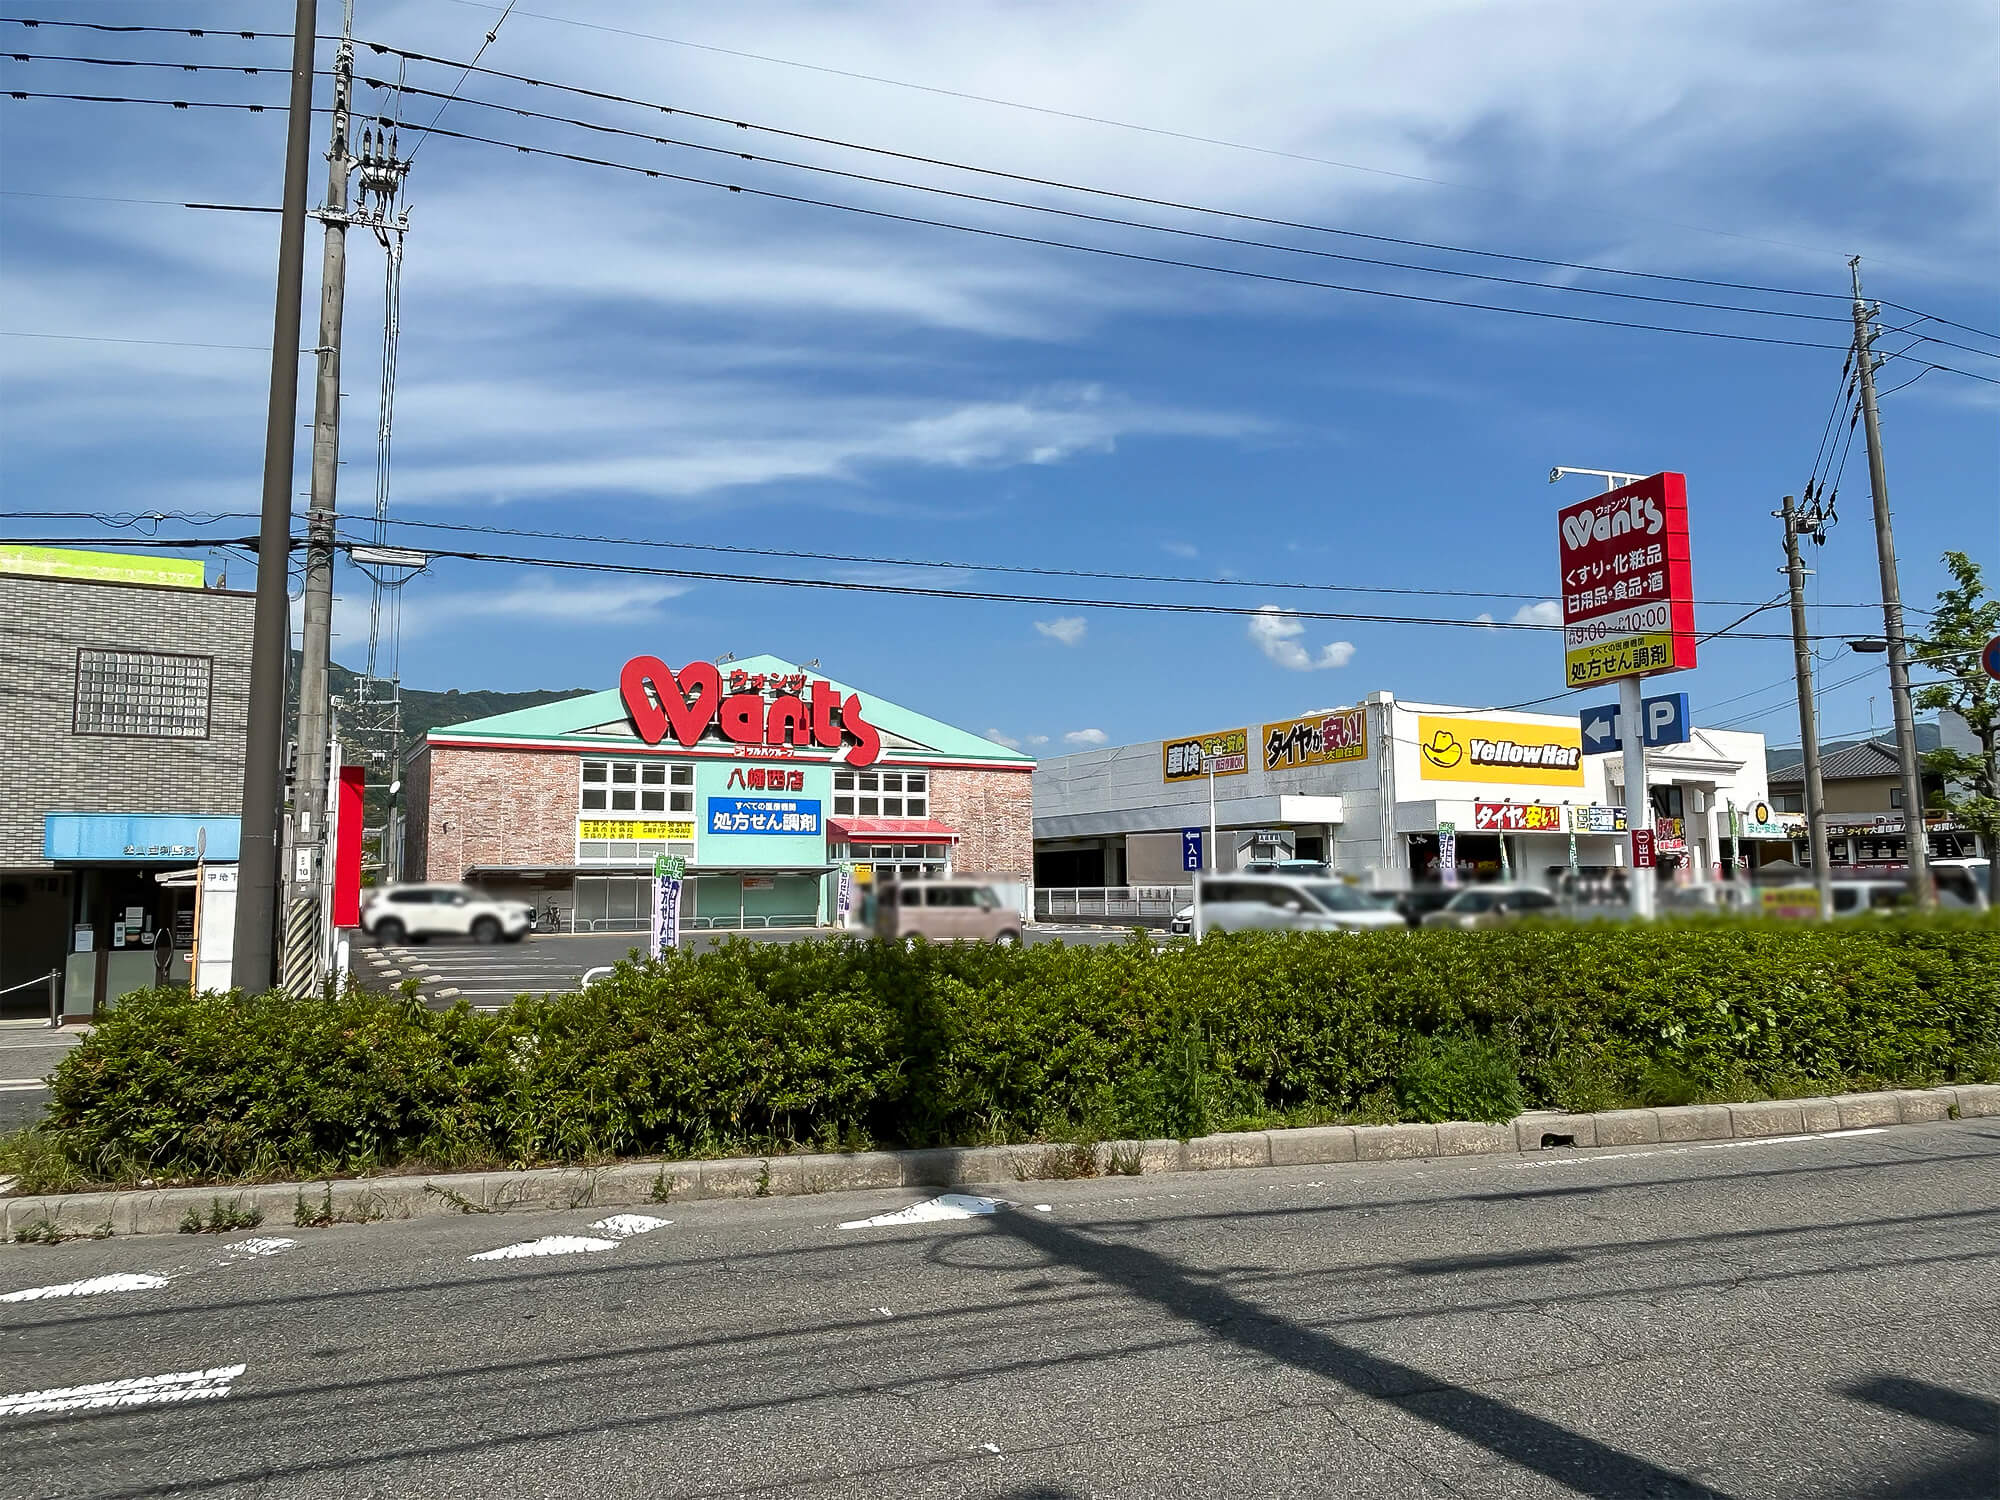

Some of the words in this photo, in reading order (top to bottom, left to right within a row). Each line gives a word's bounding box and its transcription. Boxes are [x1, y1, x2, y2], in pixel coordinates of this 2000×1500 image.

[1595, 496, 1630, 517] ウォンツ
[1562, 496, 1663, 550] Wants
[1566, 543, 1663, 587] くすり・化粧品
[1568, 570, 1664, 614] 日用品・食品・酒
[1571, 643, 1667, 681] 処方せん調剤
[729, 669, 807, 691] ウォンツ
[620, 655, 880, 767] Wants
[1649, 701, 1675, 740] P
[1167, 742, 1200, 774] 車検
[727, 767, 804, 792] 八幡西店
[713, 811, 817, 832] 処方せん調剤
[1188, 843, 1198, 868] 入口
[1639, 844, 1650, 866] 出口
